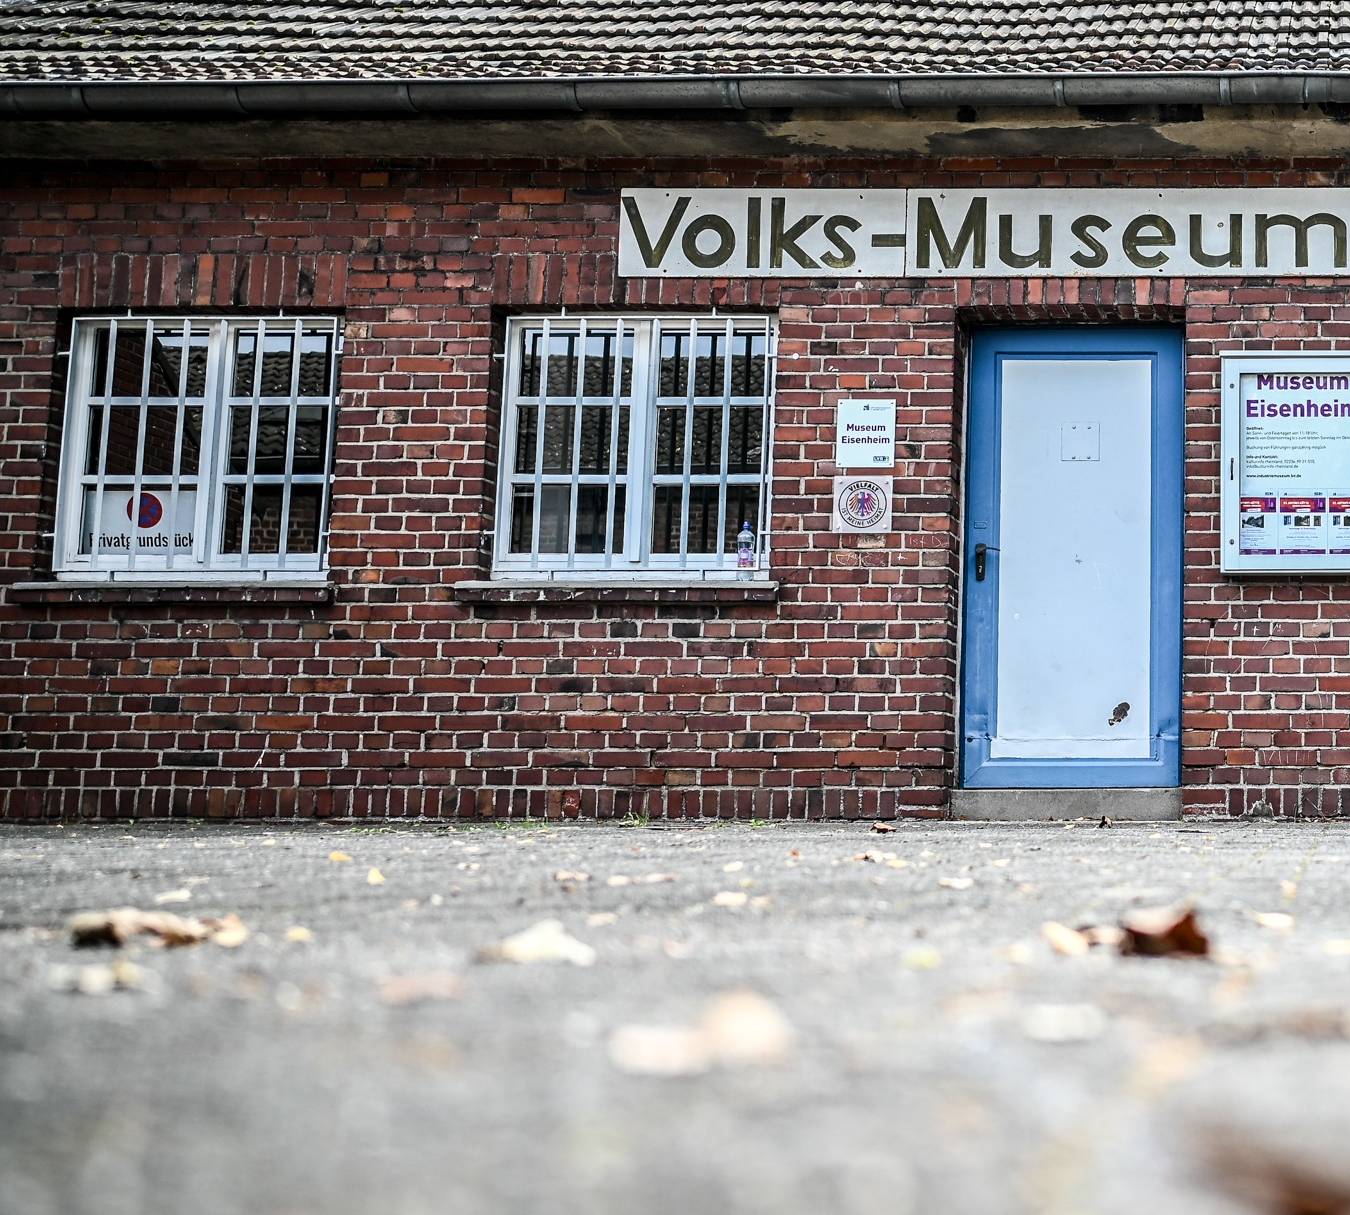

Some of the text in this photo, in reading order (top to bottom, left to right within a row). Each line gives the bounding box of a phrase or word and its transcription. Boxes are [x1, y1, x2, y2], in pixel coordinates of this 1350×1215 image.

[620, 196, 1348, 269] Volks-Museum
[1256, 374, 1349, 390] Museum
[846, 424, 886, 432] Museum
[841, 435, 890, 444] Eisenheim
[848, 482, 879, 492] VIELFALT
[847, 517, 864, 526] MEINE
[866, 508, 884, 525] HEIMAT
